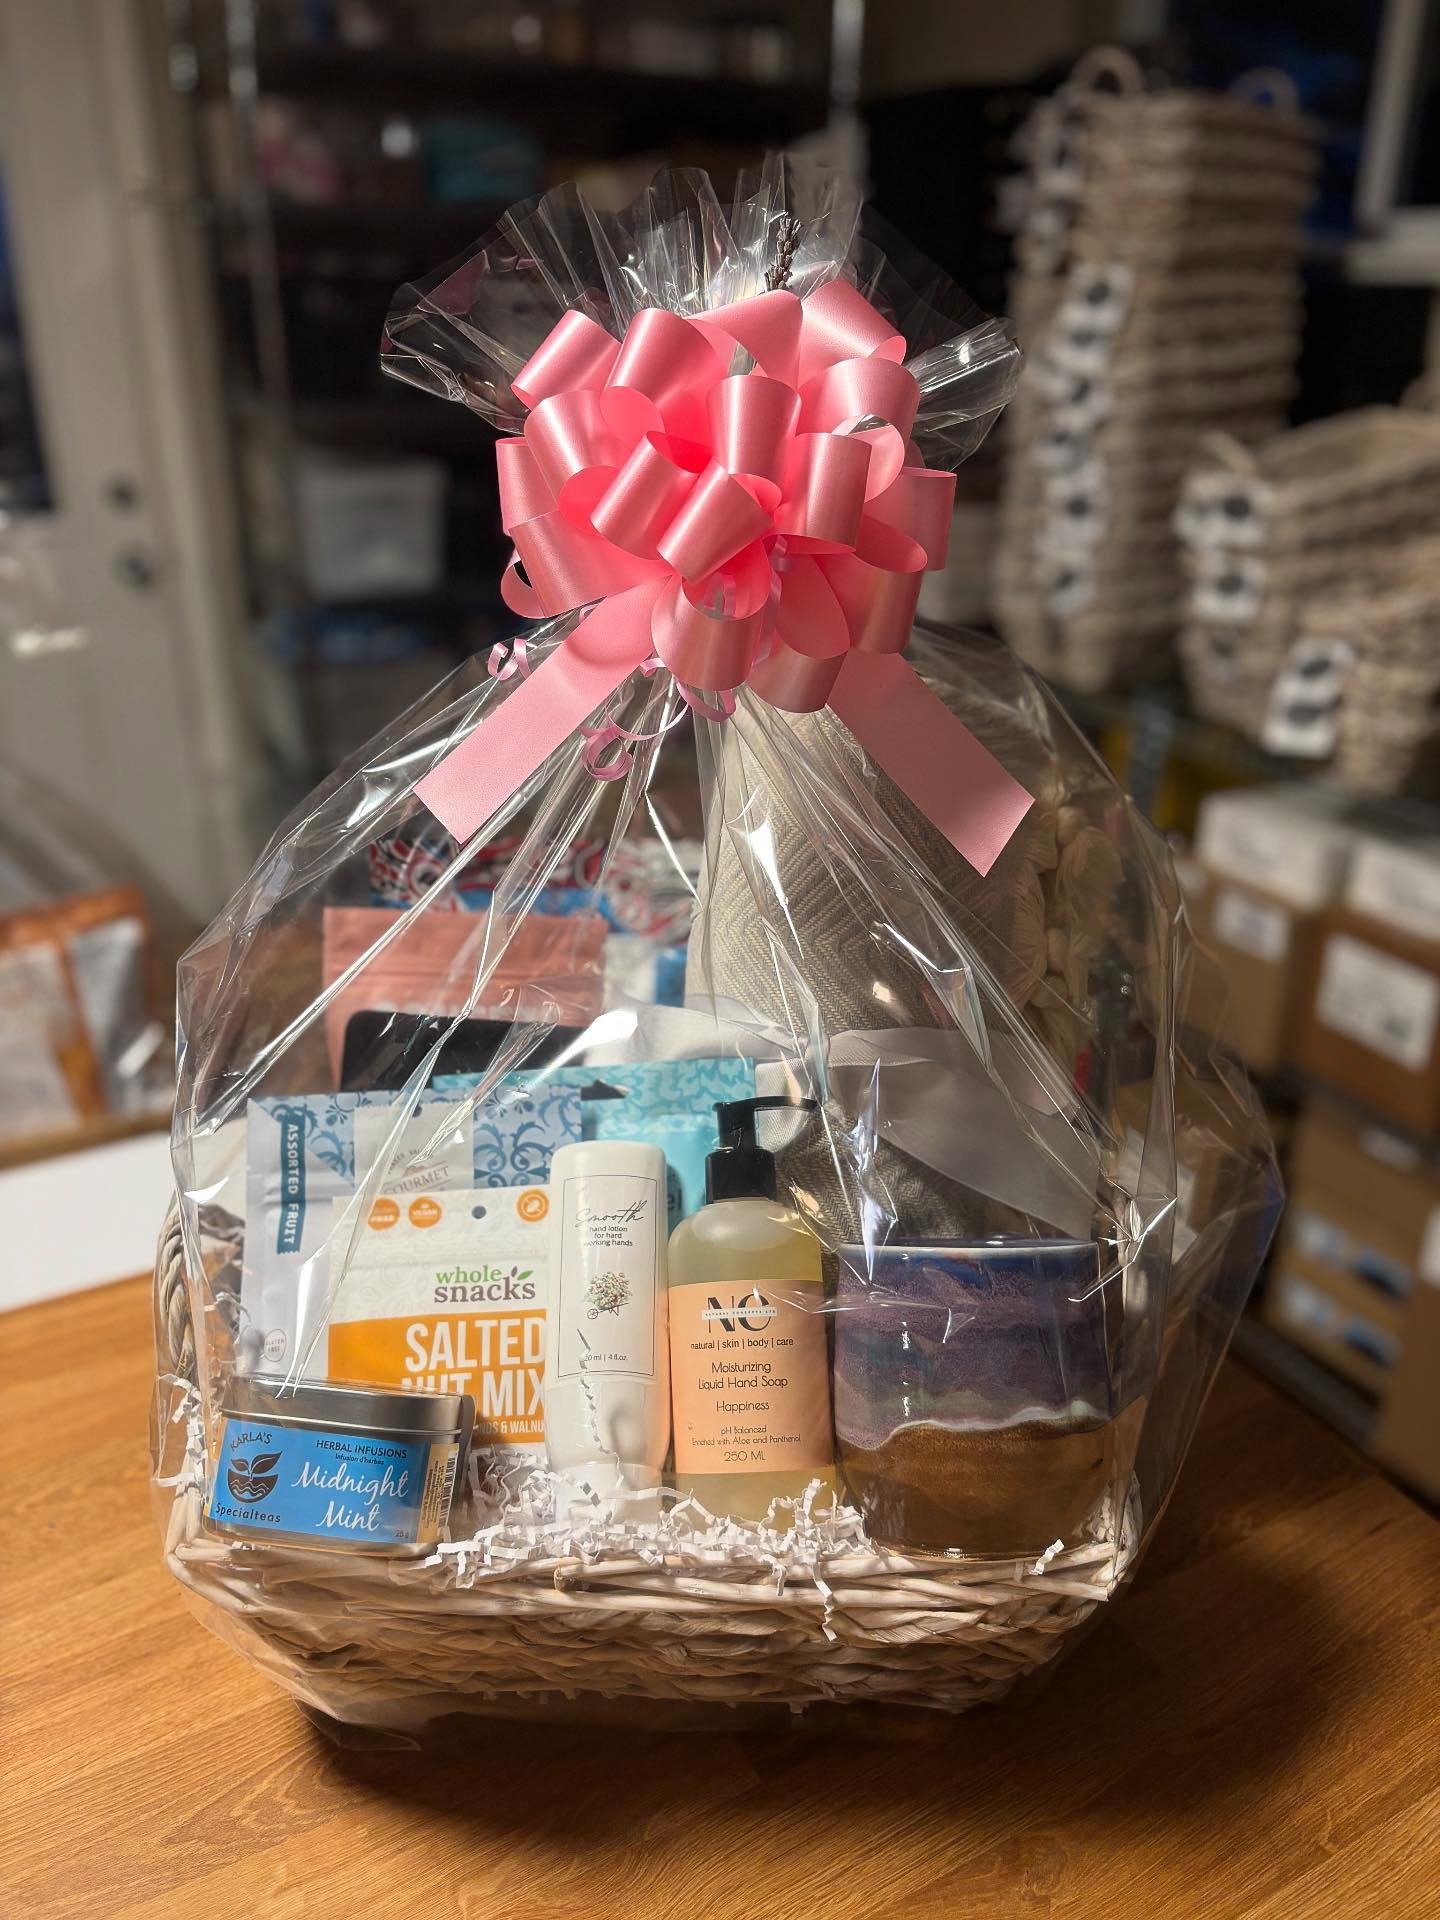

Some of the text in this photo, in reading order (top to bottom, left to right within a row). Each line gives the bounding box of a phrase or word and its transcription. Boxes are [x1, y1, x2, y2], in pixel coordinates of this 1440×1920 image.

[284, 1123, 299, 1244] ASSORTED FRUIT
[575, 1200, 648, 1228] Smooth
[612, 1238, 633, 1247] hands
[436, 1264, 502, 1284] whole
[434, 1276, 536, 1303] snacks
[405, 1318, 545, 1372] SALTED
[722, 1339, 740, 1348] skin
[747, 1338, 769, 1348] body
[776, 1338, 794, 1346] care
[711, 1362, 772, 1374] Moisturizing
[699, 1375, 788, 1391] Liquid Hand Soap
[483, 1369, 545, 1417] MIX
[716, 1400, 770, 1413] Happiness
[501, 1420, 507, 1432] &
[510, 1418, 544, 1434] WALNU
[720, 1425, 767, 1435] pH Balanced
[230, 1432, 272, 1451] KARLA'S
[316, 1439, 407, 1459] HERBAL INFUSIONS
[733, 1436, 751, 1445] Aloe
[752, 1435, 768, 1444] and
[723, 1450, 767, 1462] 250 ML
[291, 1461, 409, 1504] Midnight
[215, 1502, 281, 1524] Specialteas
[315, 1500, 380, 1531] Mint
